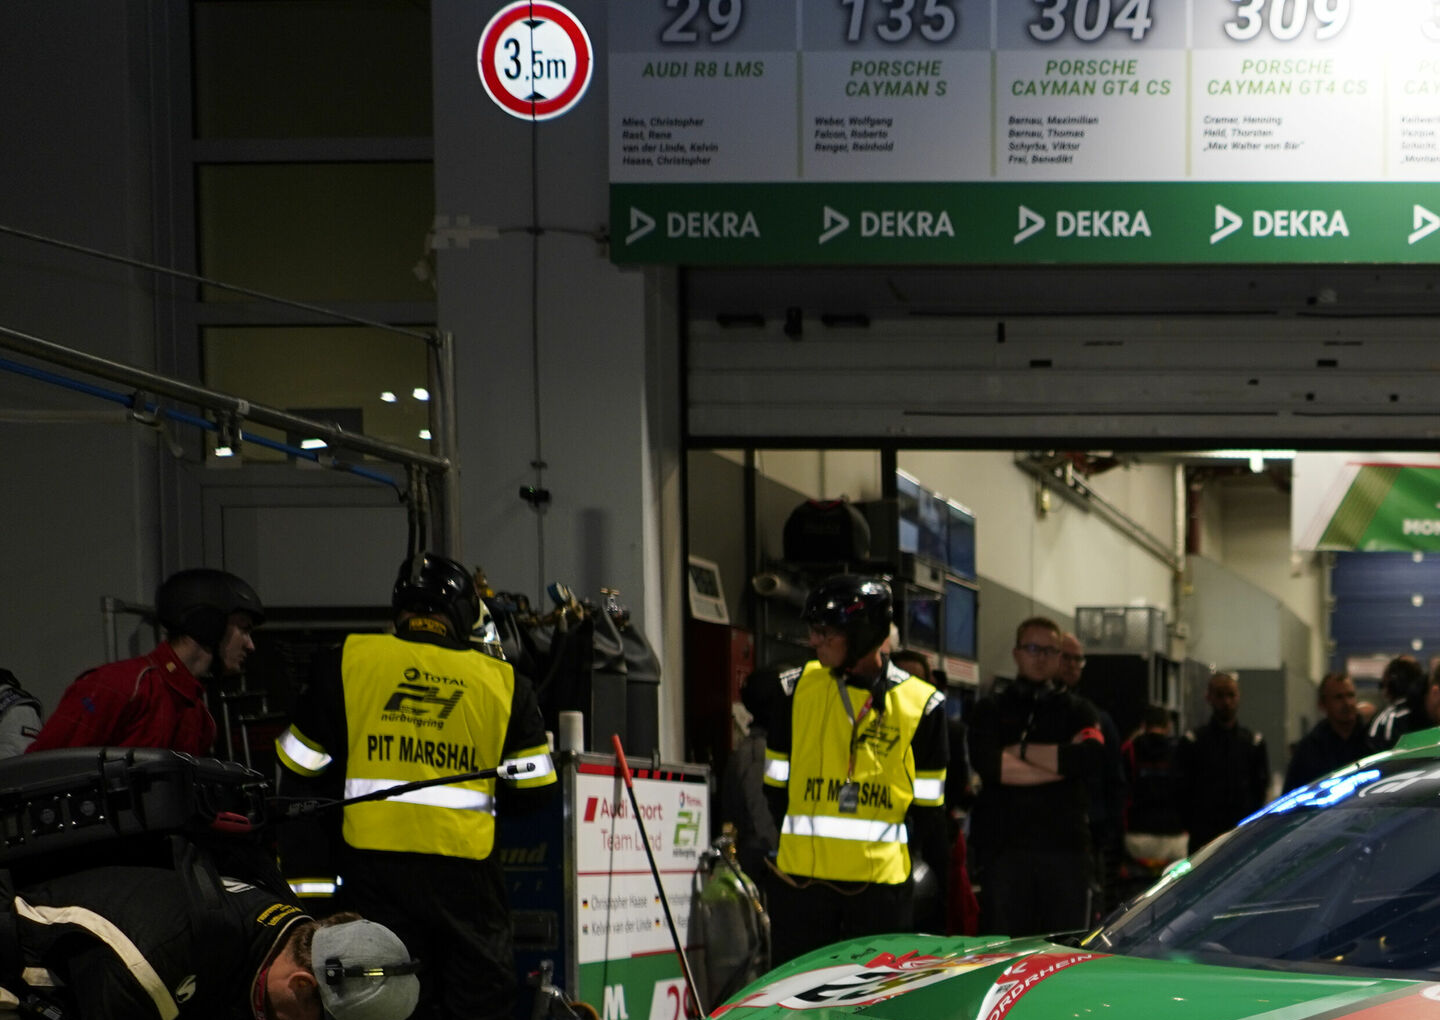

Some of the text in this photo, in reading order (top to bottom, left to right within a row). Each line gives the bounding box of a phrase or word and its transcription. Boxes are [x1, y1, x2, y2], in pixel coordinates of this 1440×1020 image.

[662, 0, 742, 43] 29
[847, 0, 957, 42] 135
[1028, 0, 1153, 41] 304
[1223, 0, 1350, 41] 309
[642, 62, 764, 77] AUDI R8 LMS
[850, 61, 942, 77] PORSCHE
[1045, 60, 1138, 76] PORSCHE
[1241, 59, 1334, 75] PORSCHE
[845, 80, 947, 98] CAYMAN S
[1011, 80, 1172, 96] CAYMAN GT4 CS
[1207, 79, 1368, 96] CAYMAN GT4 CS
[650, 118, 704, 129] Christopher
[849, 116, 893, 129] Wolfgang
[851, 130, 888, 139] Roberto
[657, 157, 711, 167] Christopher
[667, 211, 761, 238] DEKRA
[860, 211, 954, 238] DEKRA
[1055, 210, 1151, 238] DEKRA
[1253, 210, 1350, 237] DEKRA
[423, 672, 468, 688] TOTAL
[381, 712, 444, 730] nürburgring
[367, 735, 479, 772] PIT MARSHAL
[804, 778, 894, 809] PIT MRSHAL
